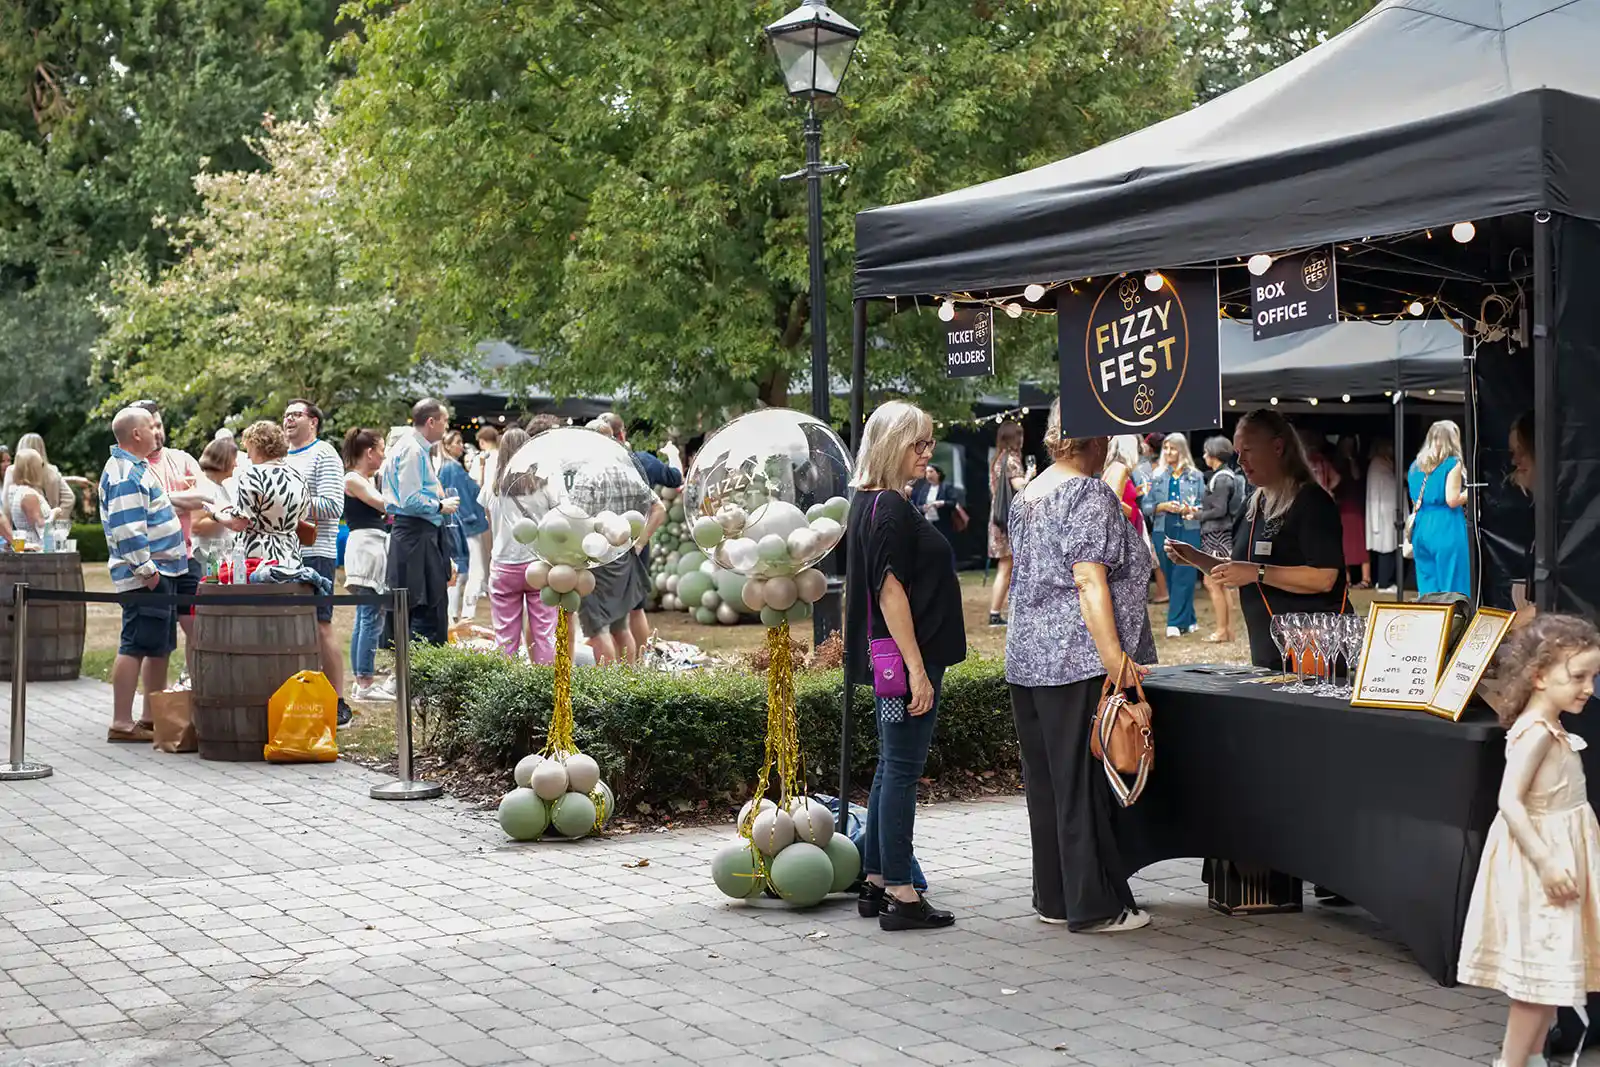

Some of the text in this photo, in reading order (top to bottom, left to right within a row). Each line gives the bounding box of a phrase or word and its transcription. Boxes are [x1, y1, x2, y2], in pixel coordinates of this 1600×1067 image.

[1304, 258, 1327, 275] FIZZY
[1305, 267, 1328, 285] FEST
[1256, 281, 1285, 302] BOX
[1257, 301, 1308, 326] OFFICE
[1095, 299, 1172, 355] FIZZY
[947, 330, 974, 345] TICKET
[948, 350, 986, 365] HOLDERS
[1100, 336, 1177, 393] FEST
[707, 471, 756, 500] FIZZY
[1411, 667, 1428, 675] £20
[1412, 678, 1426, 686] £15
[1369, 686, 1400, 694] Glasses
[1408, 688, 1425, 696] £79
